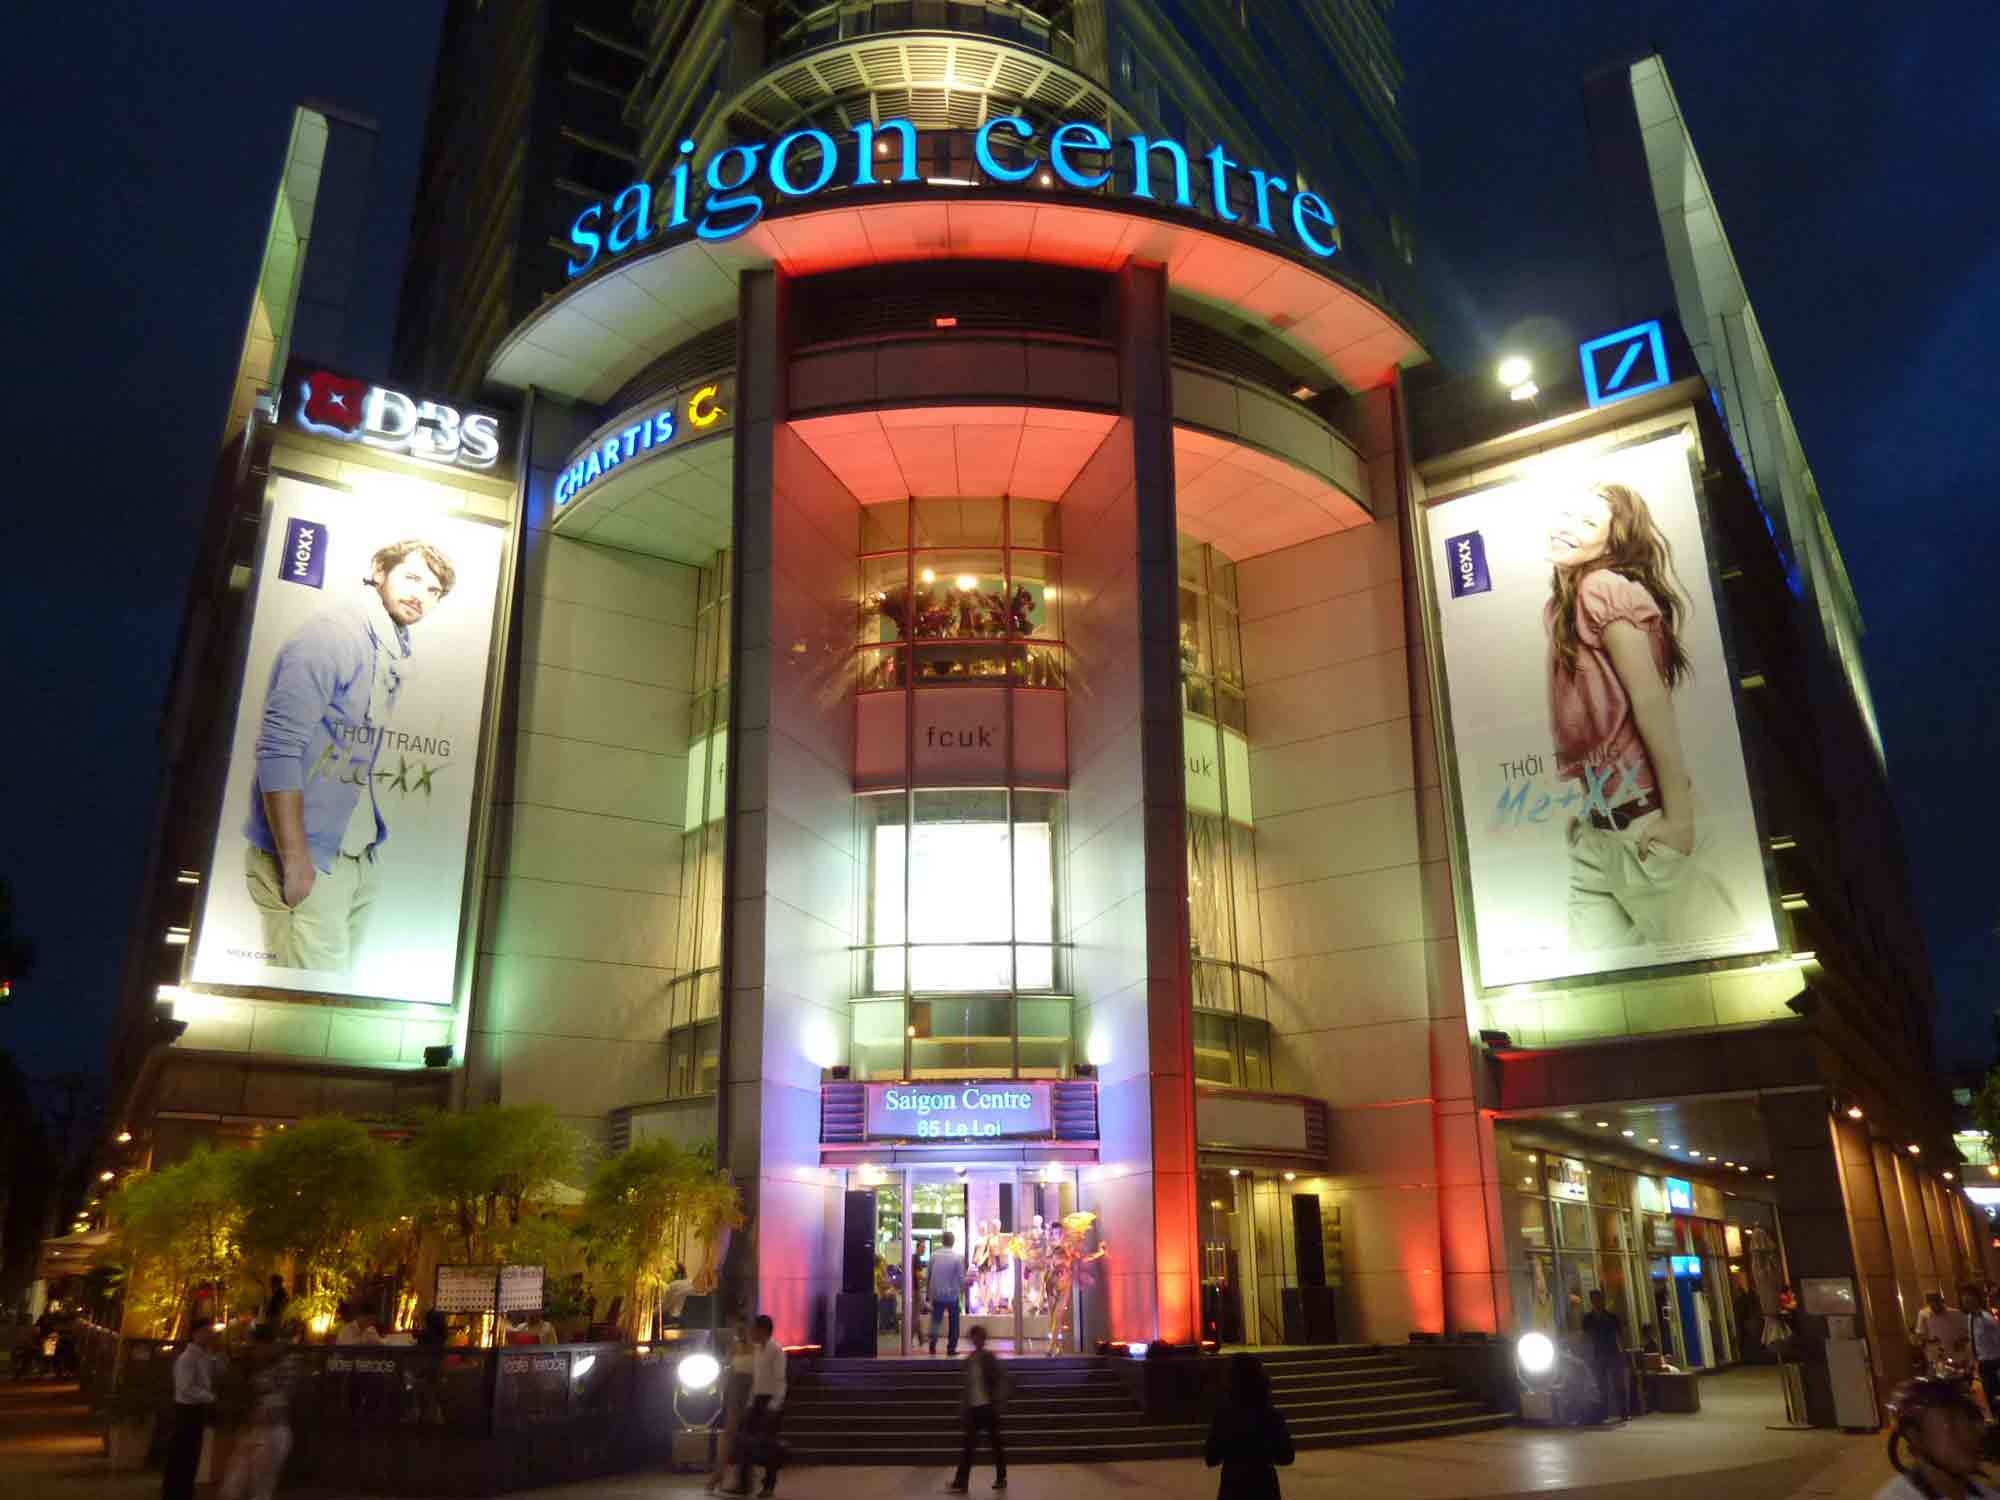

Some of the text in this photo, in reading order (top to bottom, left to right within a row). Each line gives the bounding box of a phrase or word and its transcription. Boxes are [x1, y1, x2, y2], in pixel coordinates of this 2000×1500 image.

[566, 115, 1338, 278] saigon centre
[362, 386, 499, 468] DBS
[554, 410, 674, 505] CHARTIS
[384, 729, 451, 758] TRANG
[925, 725, 993, 748] fcuk
[885, 1088, 1032, 1115] Saigon Centre
